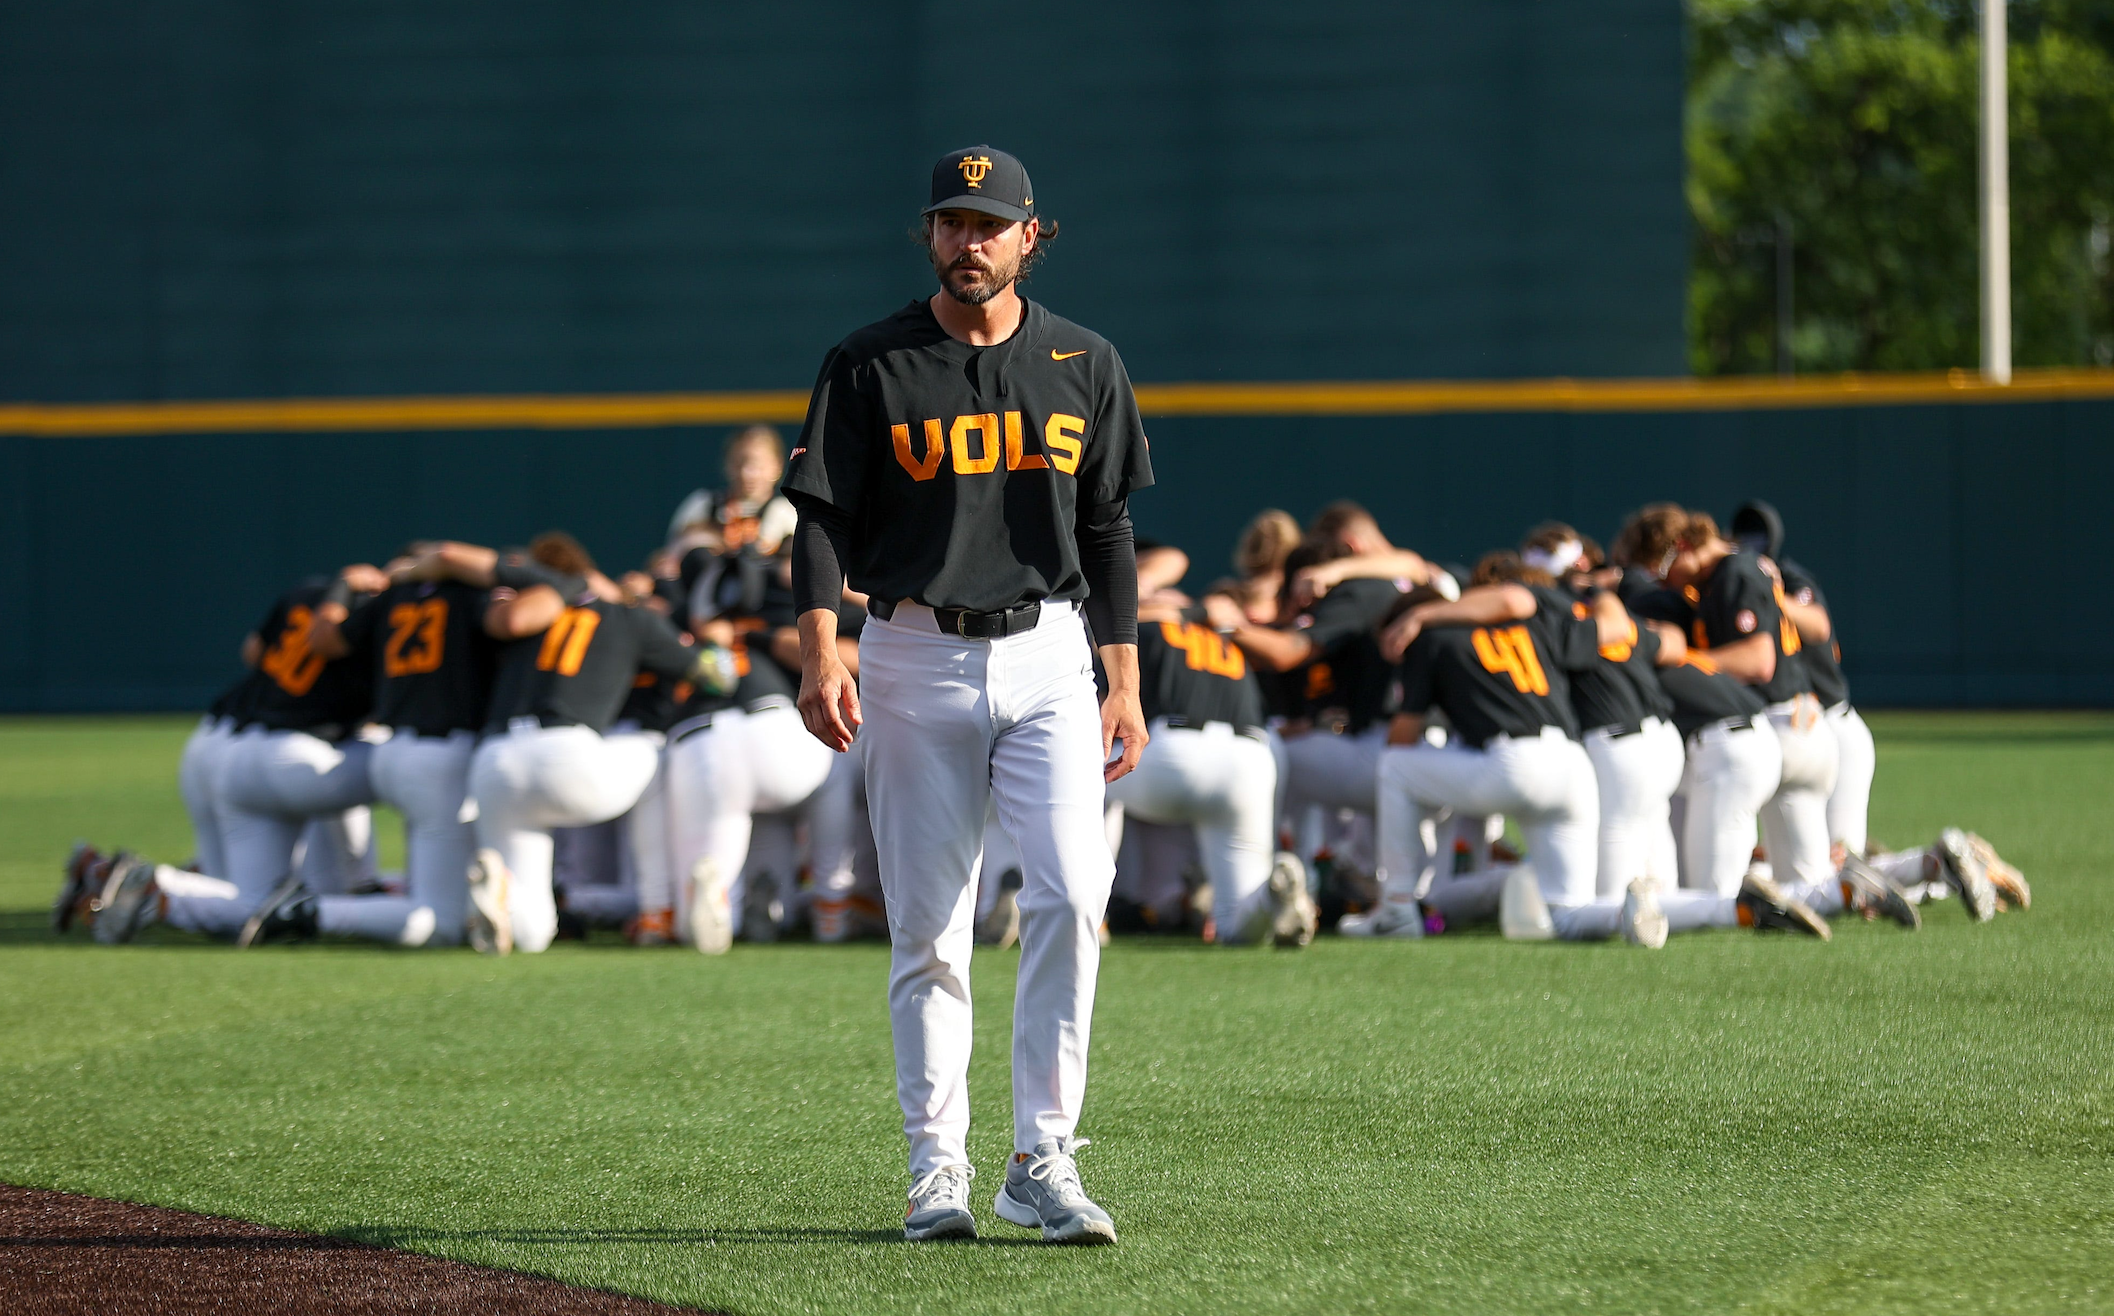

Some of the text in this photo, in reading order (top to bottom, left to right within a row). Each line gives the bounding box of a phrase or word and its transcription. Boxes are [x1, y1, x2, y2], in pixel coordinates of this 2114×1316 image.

[890, 410, 1086, 482] VOLS
[384, 598, 449, 678] 23
[1470, 624, 1550, 697] 41
